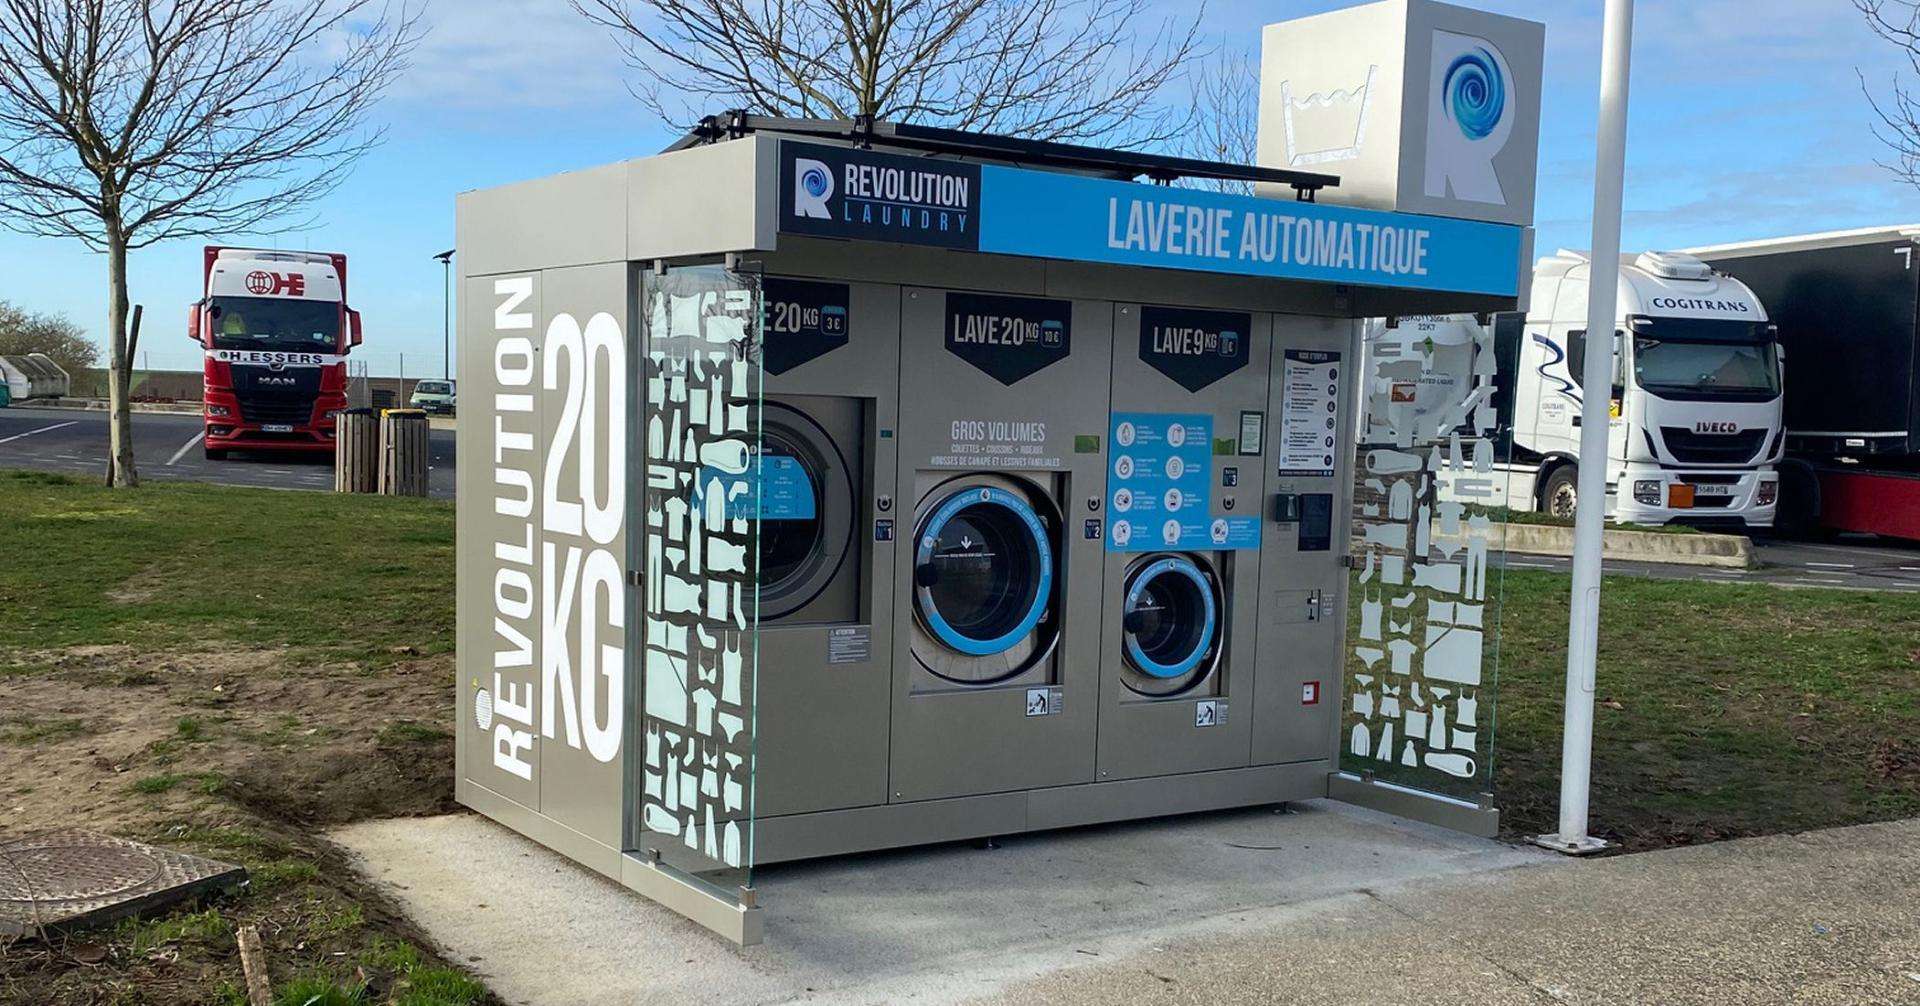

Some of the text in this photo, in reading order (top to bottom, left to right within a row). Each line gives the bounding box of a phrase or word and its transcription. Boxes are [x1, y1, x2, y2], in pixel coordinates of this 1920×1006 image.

[1424, 29, 1516, 205] R
[844, 163, 969, 208] REVOLUTION
[844, 202, 967, 232] LAUNDRY
[1107, 197, 1430, 276] LAVERIE AUTOMATIQUE
[774, 302, 801, 333] 20
[803, 308, 819, 326] KG
[1652, 297, 1748, 312] COGITRANS
[954, 314, 1039, 346] LAVE 20 KG
[1153, 326, 1218, 355] LAVE 9 KG
[230, 352, 323, 364] H.ESSERS
[258, 377, 296, 385] MAN
[543, 312, 626, 544] 20
[951, 420, 1046, 442] GROS VOLUMES
[1696, 422, 1737, 432] IVECO
[951, 443, 980, 454] COUETTES
[959, 456, 967, 466] DE
[992, 457, 1000, 466] ET
[493, 277, 534, 781] REVOLUTION
[541, 541, 625, 763] KG
